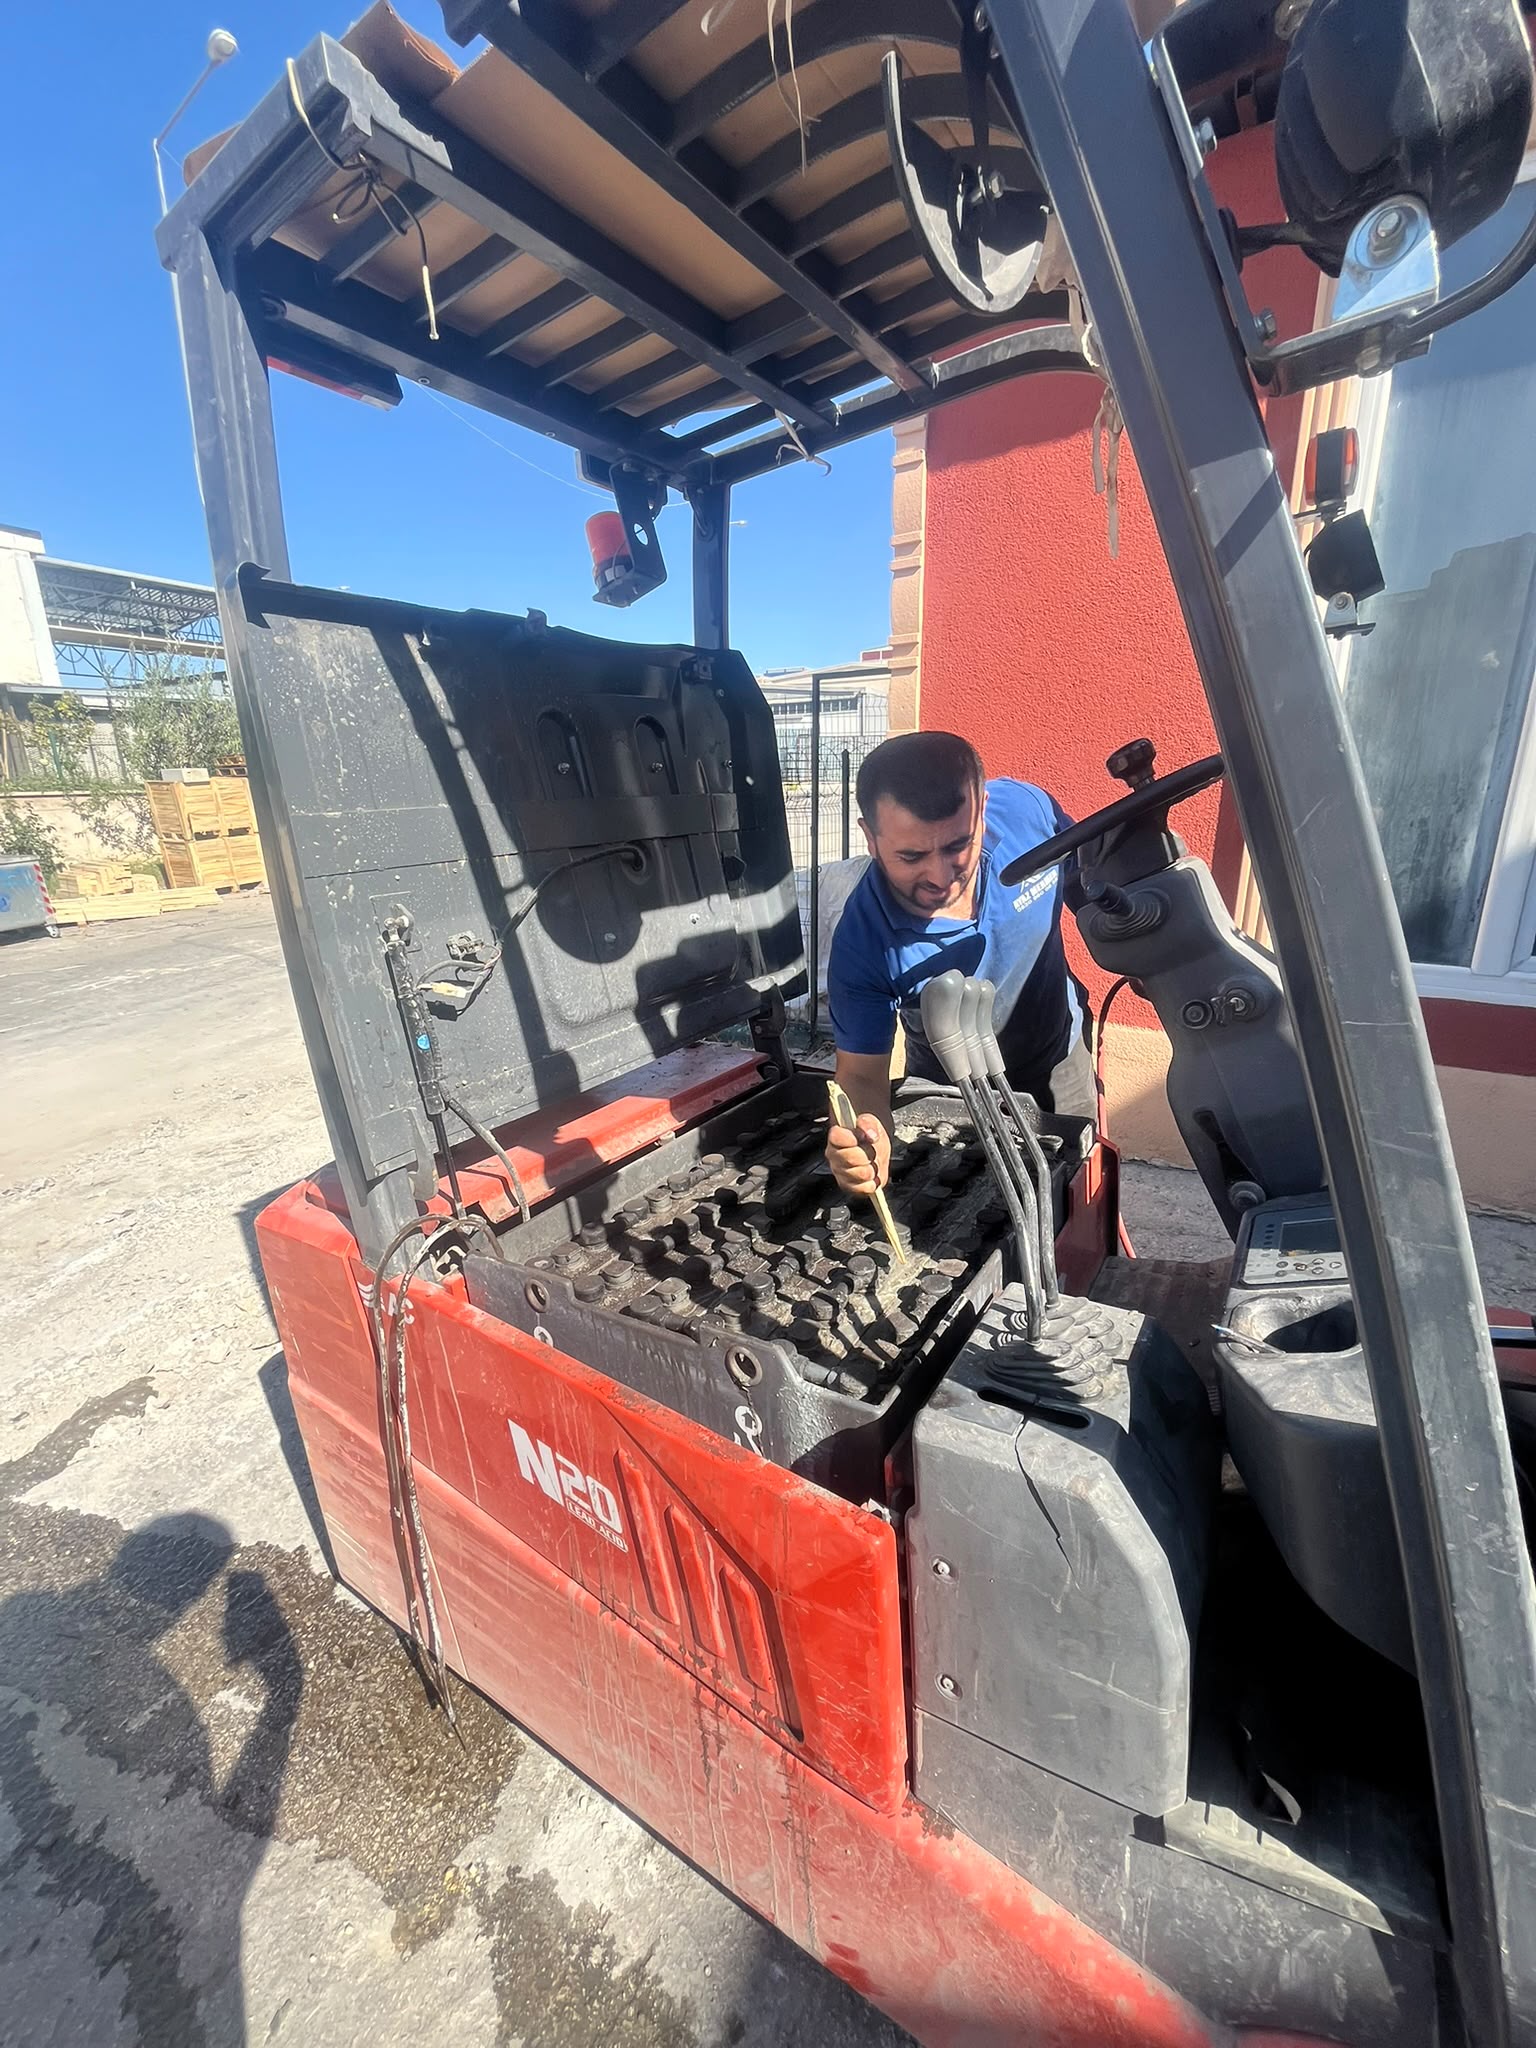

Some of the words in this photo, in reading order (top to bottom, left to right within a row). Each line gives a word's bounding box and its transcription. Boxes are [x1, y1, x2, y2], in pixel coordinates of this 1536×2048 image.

[508, 1419, 622, 1534] N20
[568, 1501, 596, 1529] LEAD
[599, 1525, 625, 1549] ACID
